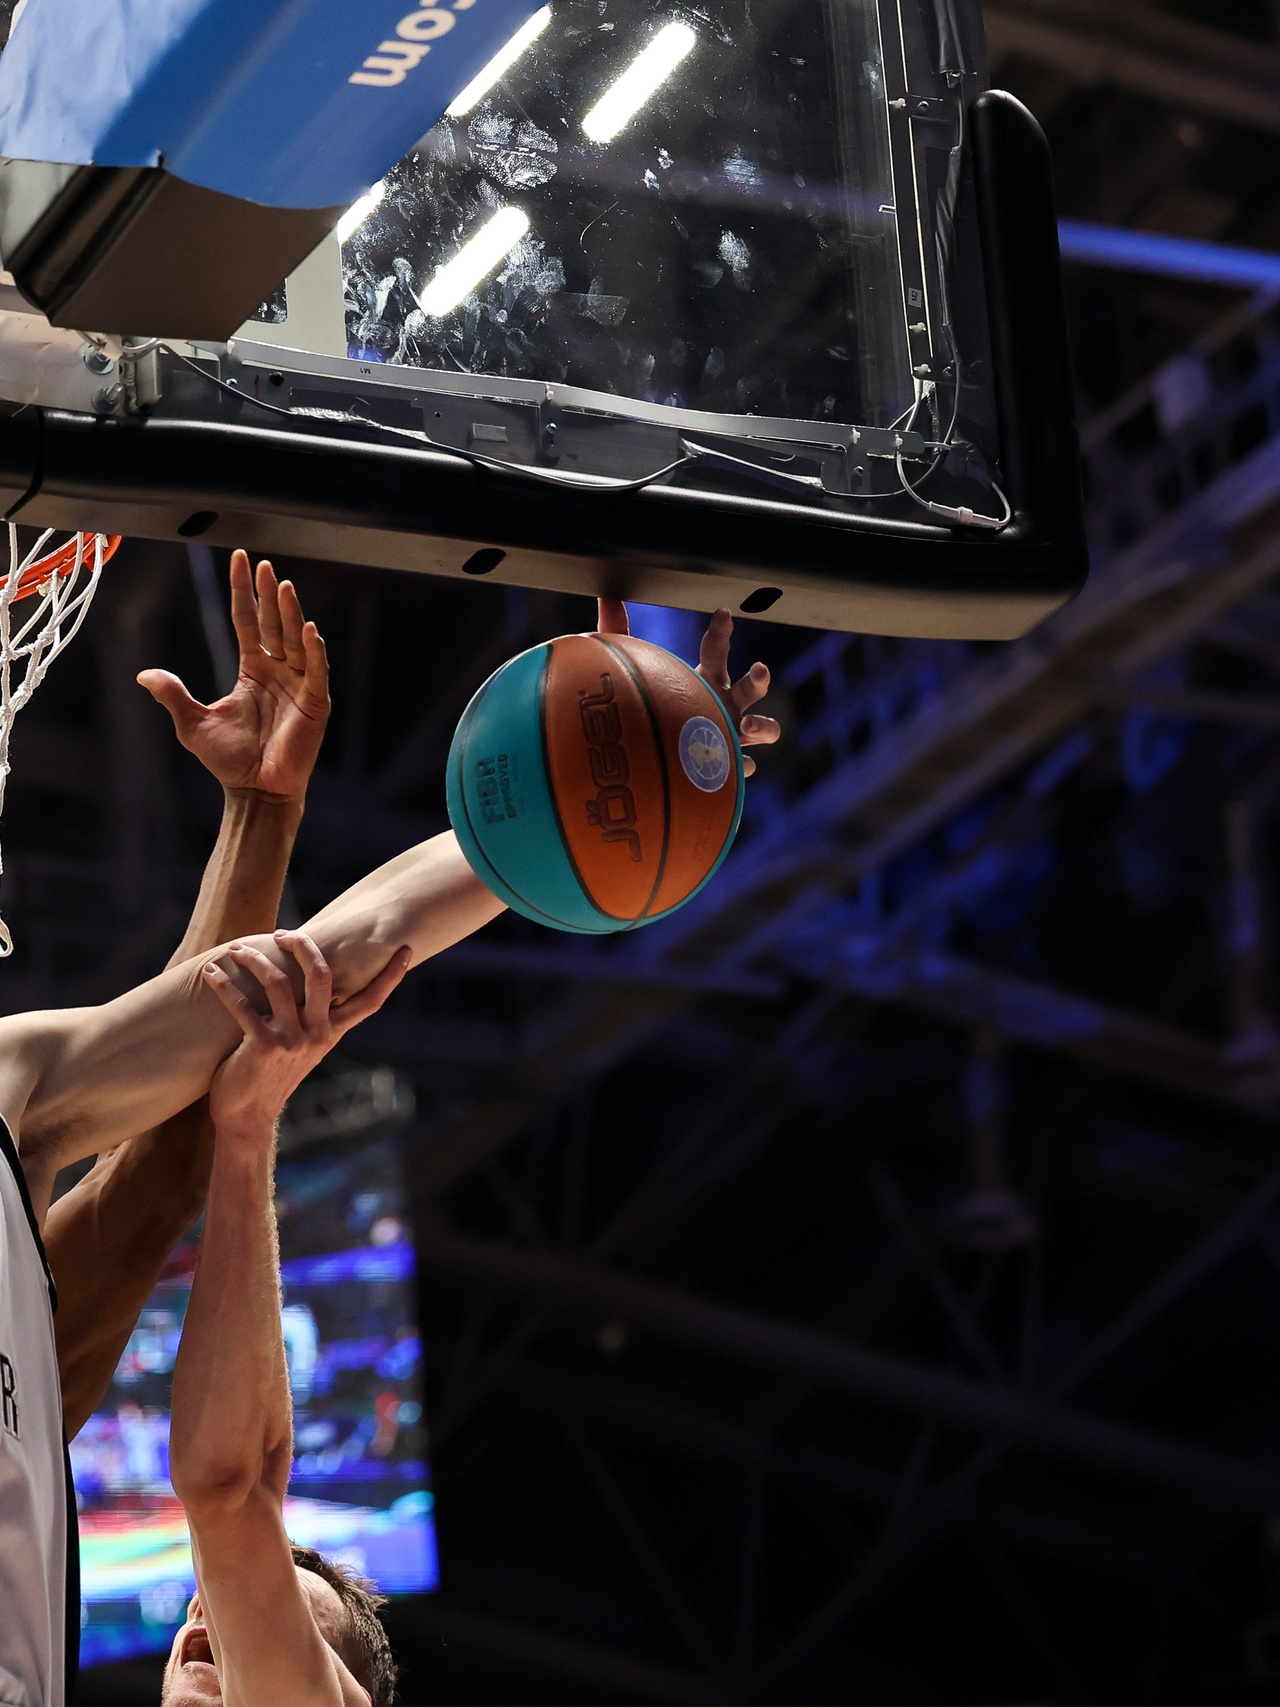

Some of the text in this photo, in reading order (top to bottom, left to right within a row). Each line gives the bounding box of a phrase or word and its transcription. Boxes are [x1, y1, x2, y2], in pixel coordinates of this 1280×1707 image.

[475, 757, 506, 824] FIBA
[498, 753, 518, 819] APPROVED
[578, 673, 642, 862] JÖGEL
